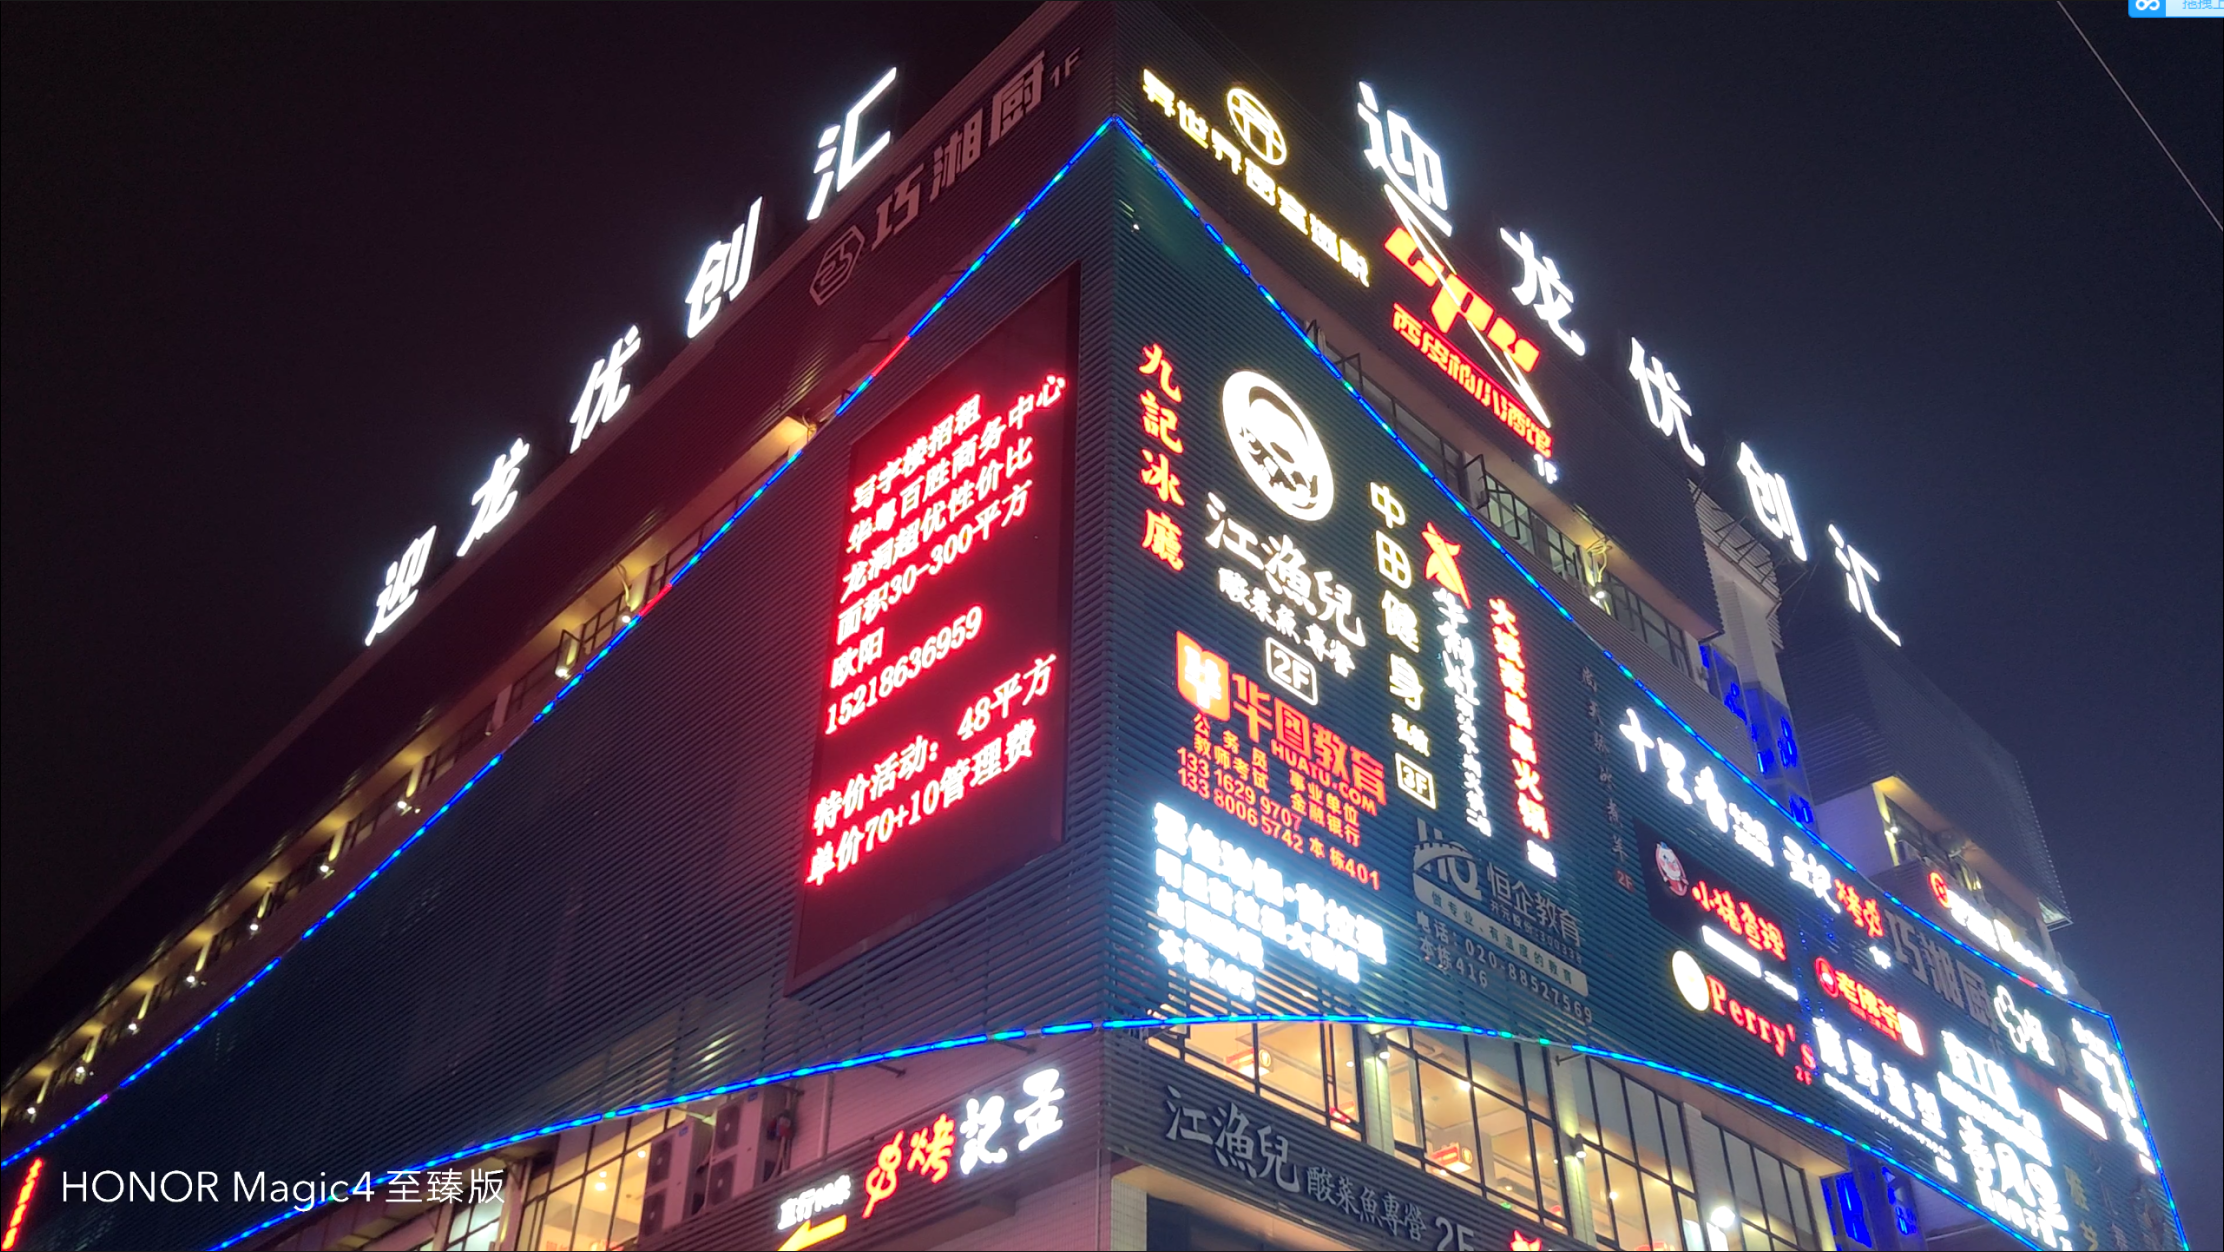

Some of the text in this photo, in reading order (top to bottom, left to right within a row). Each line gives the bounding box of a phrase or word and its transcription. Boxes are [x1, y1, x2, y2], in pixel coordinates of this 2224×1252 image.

[871, 47, 1081, 251] 巧湘厨 1F
[366, 66, 897, 646] 迎龙优创汇
[1358, 81, 1902, 646] 迎龙优创汇
[851, 394, 982, 513] 写字楼招租
[836, 479, 1033, 645] 面积30-300平方
[840, 436, 1034, 604] 龙洞超优性价比
[1205, 492, 1366, 648] 江漁兒
[1371, 482, 1422, 712] 中田健身
[825, 606, 983, 735] 15218636959
[830, 627, 885, 689] 欧阳
[957, 653, 1057, 741] 48平方
[1273, 649, 1311, 690] 2F
[1177, 747, 1302, 831] 133 1629 9707
[1193, 713, 1361, 829] 公务员 事业单位
[1193, 733, 1361, 848] 教师考试 金融银行
[1232, 672, 1388, 806] 华图教育
[1271, 739, 1378, 816] HUATU.COM
[1402, 763, 1430, 795] 3F
[805, 718, 1037, 886] 单价70+10管理费
[1178, 768, 1210, 799] 133
[1213, 788, 1259, 828] 8006
[1261, 817, 1304, 854] 5742
[1487, 862, 1581, 947] 恒企教育
[1615, 869, 1636, 893] 2F
[1692, 880, 1786, 961] 小猪查理
[1884, 909, 1999, 1034] 巧湘厨
[1166, 1084, 1300, 1193] 江漁兒
[1307, 1166, 1476, 1252] 酸菜魚專營 2F
